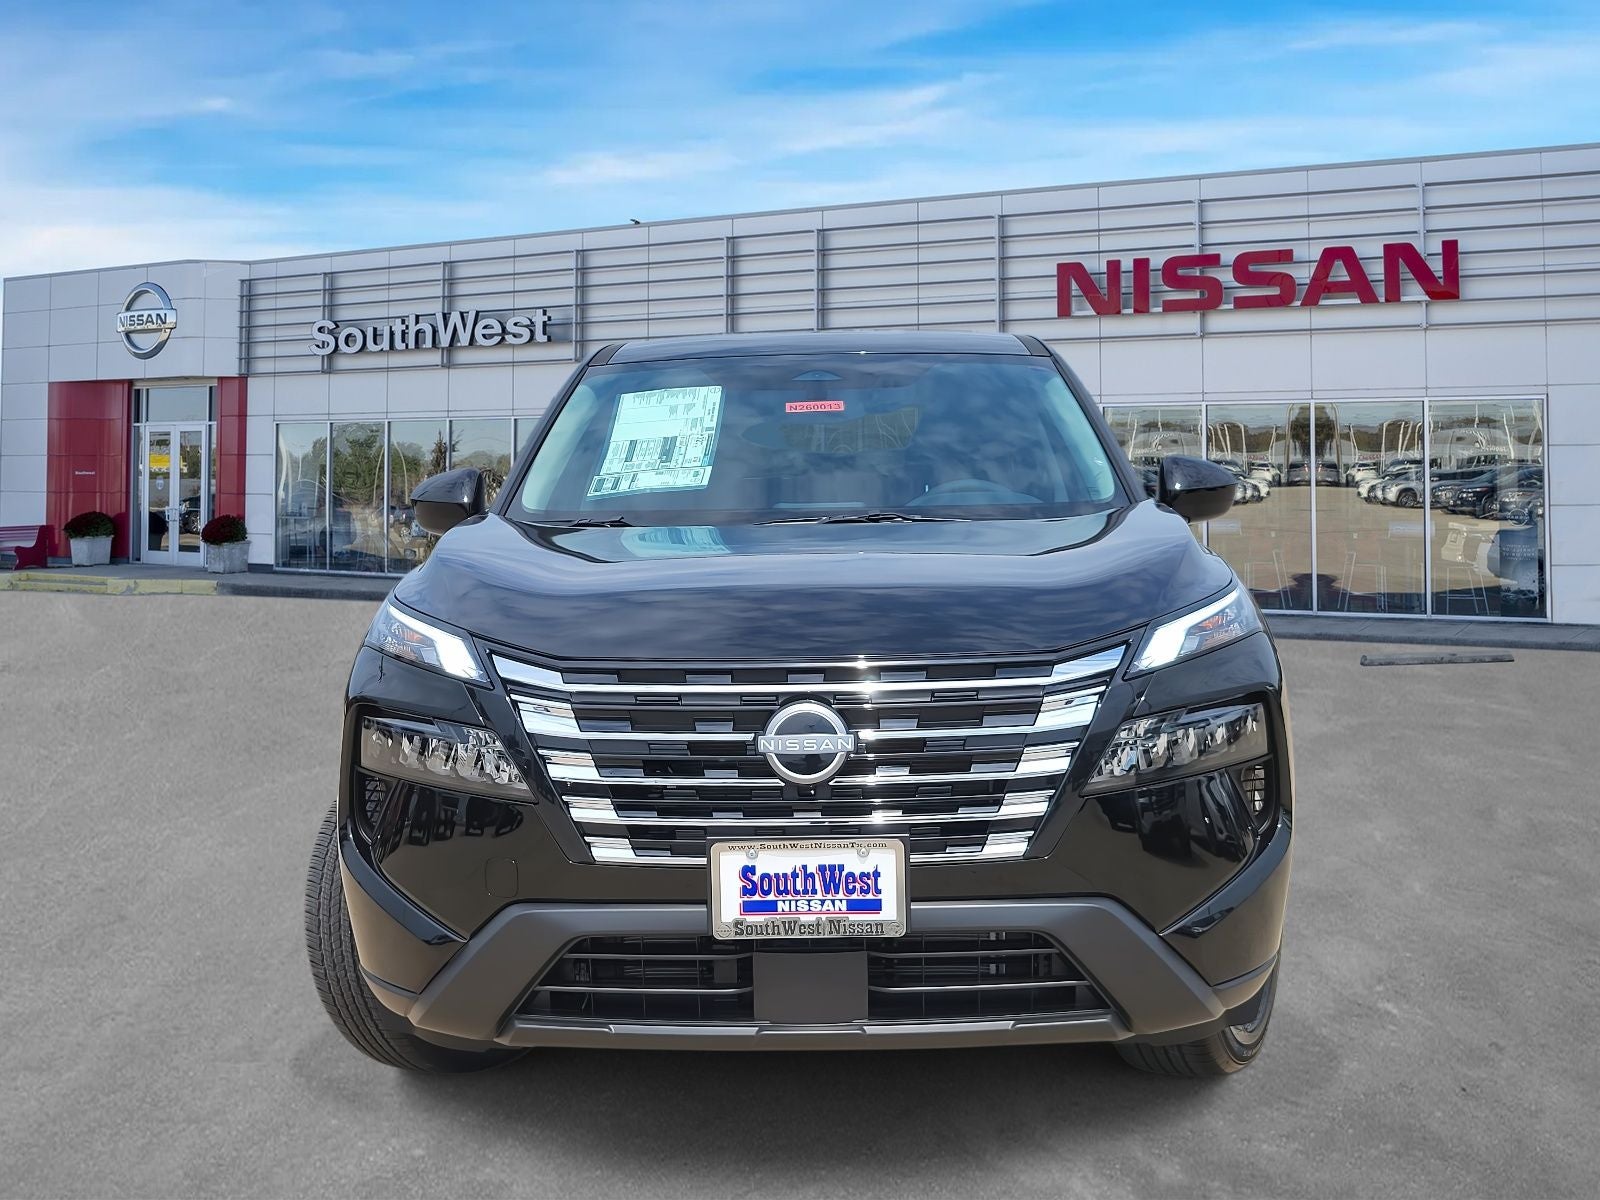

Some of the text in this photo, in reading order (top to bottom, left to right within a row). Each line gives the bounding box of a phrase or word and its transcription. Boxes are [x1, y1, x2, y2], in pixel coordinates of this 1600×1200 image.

[1056, 238, 1461, 318] NISSAN
[118, 312, 168, 329] NISSAN
[308, 308, 552, 356] SouthWest
[788, 403, 842, 412] N260013
[760, 737, 853, 752] NISSAN
[739, 863, 882, 898] SouthWest
[777, 899, 848, 913] NISSAN
[734, 918, 886, 937] SouthWest Nissan
